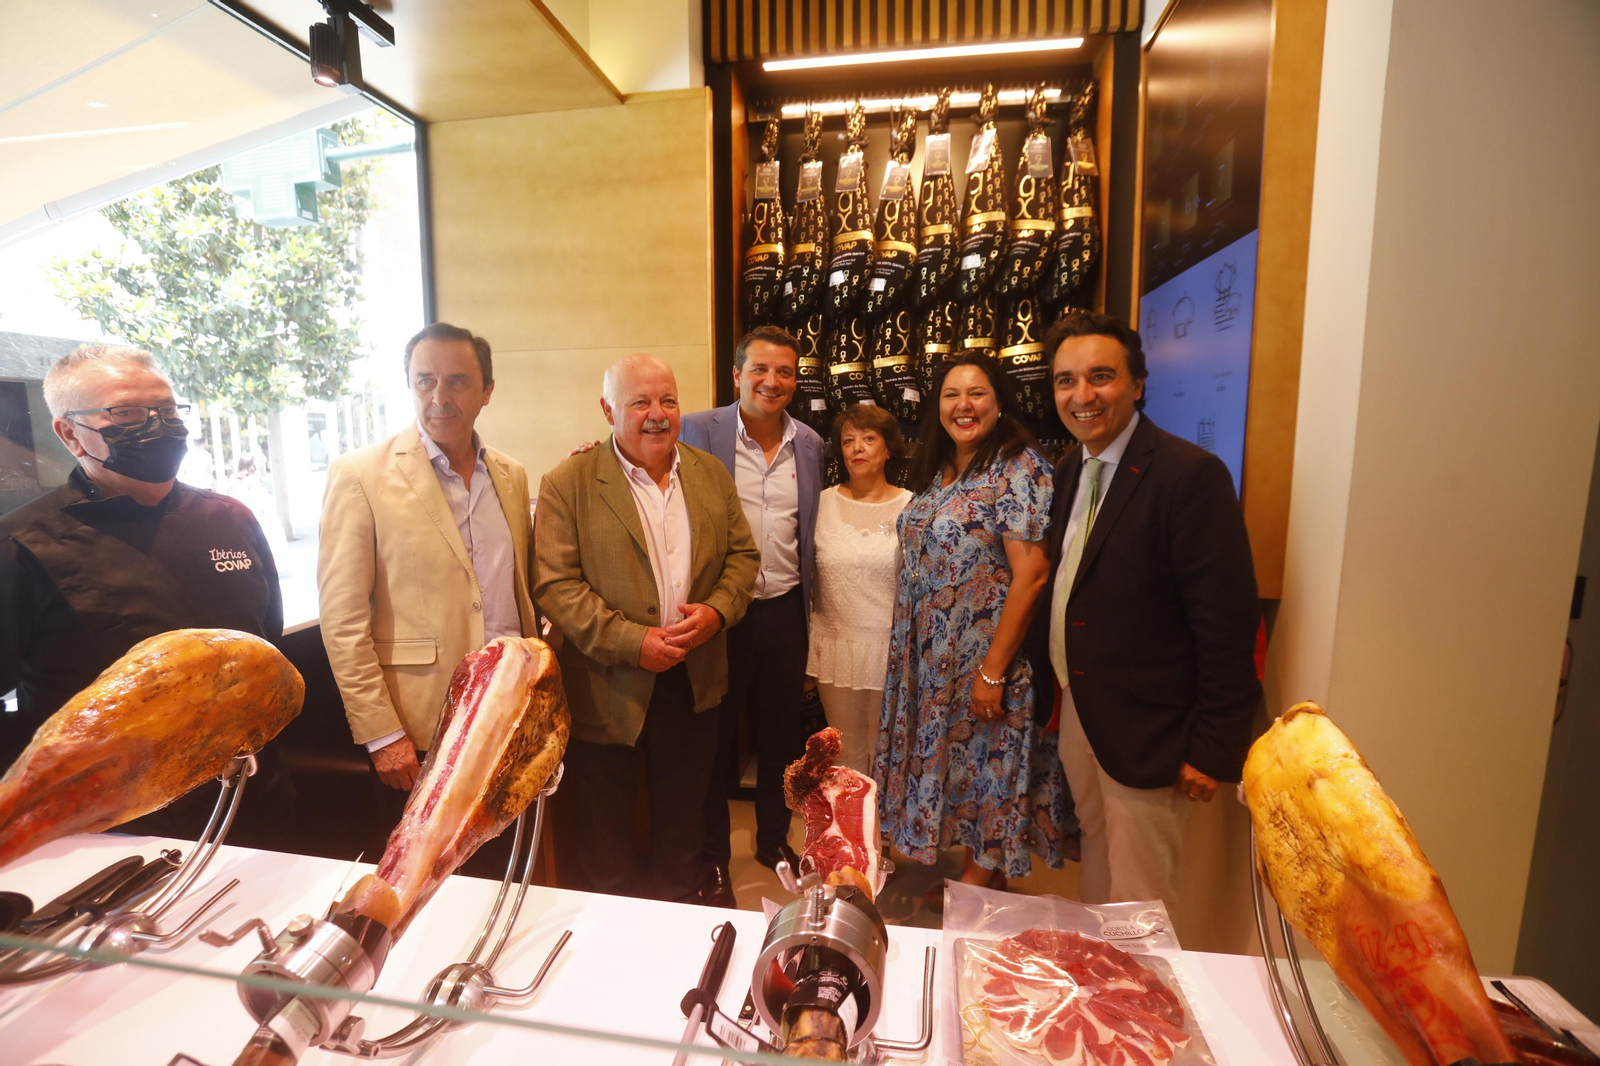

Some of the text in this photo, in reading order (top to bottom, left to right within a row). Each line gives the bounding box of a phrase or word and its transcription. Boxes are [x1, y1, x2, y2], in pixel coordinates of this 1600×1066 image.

[1012, 353, 1042, 365] COVAP
[215, 559, 252, 572] COVAP
[1103, 929, 1145, 937] CUCHILLO
